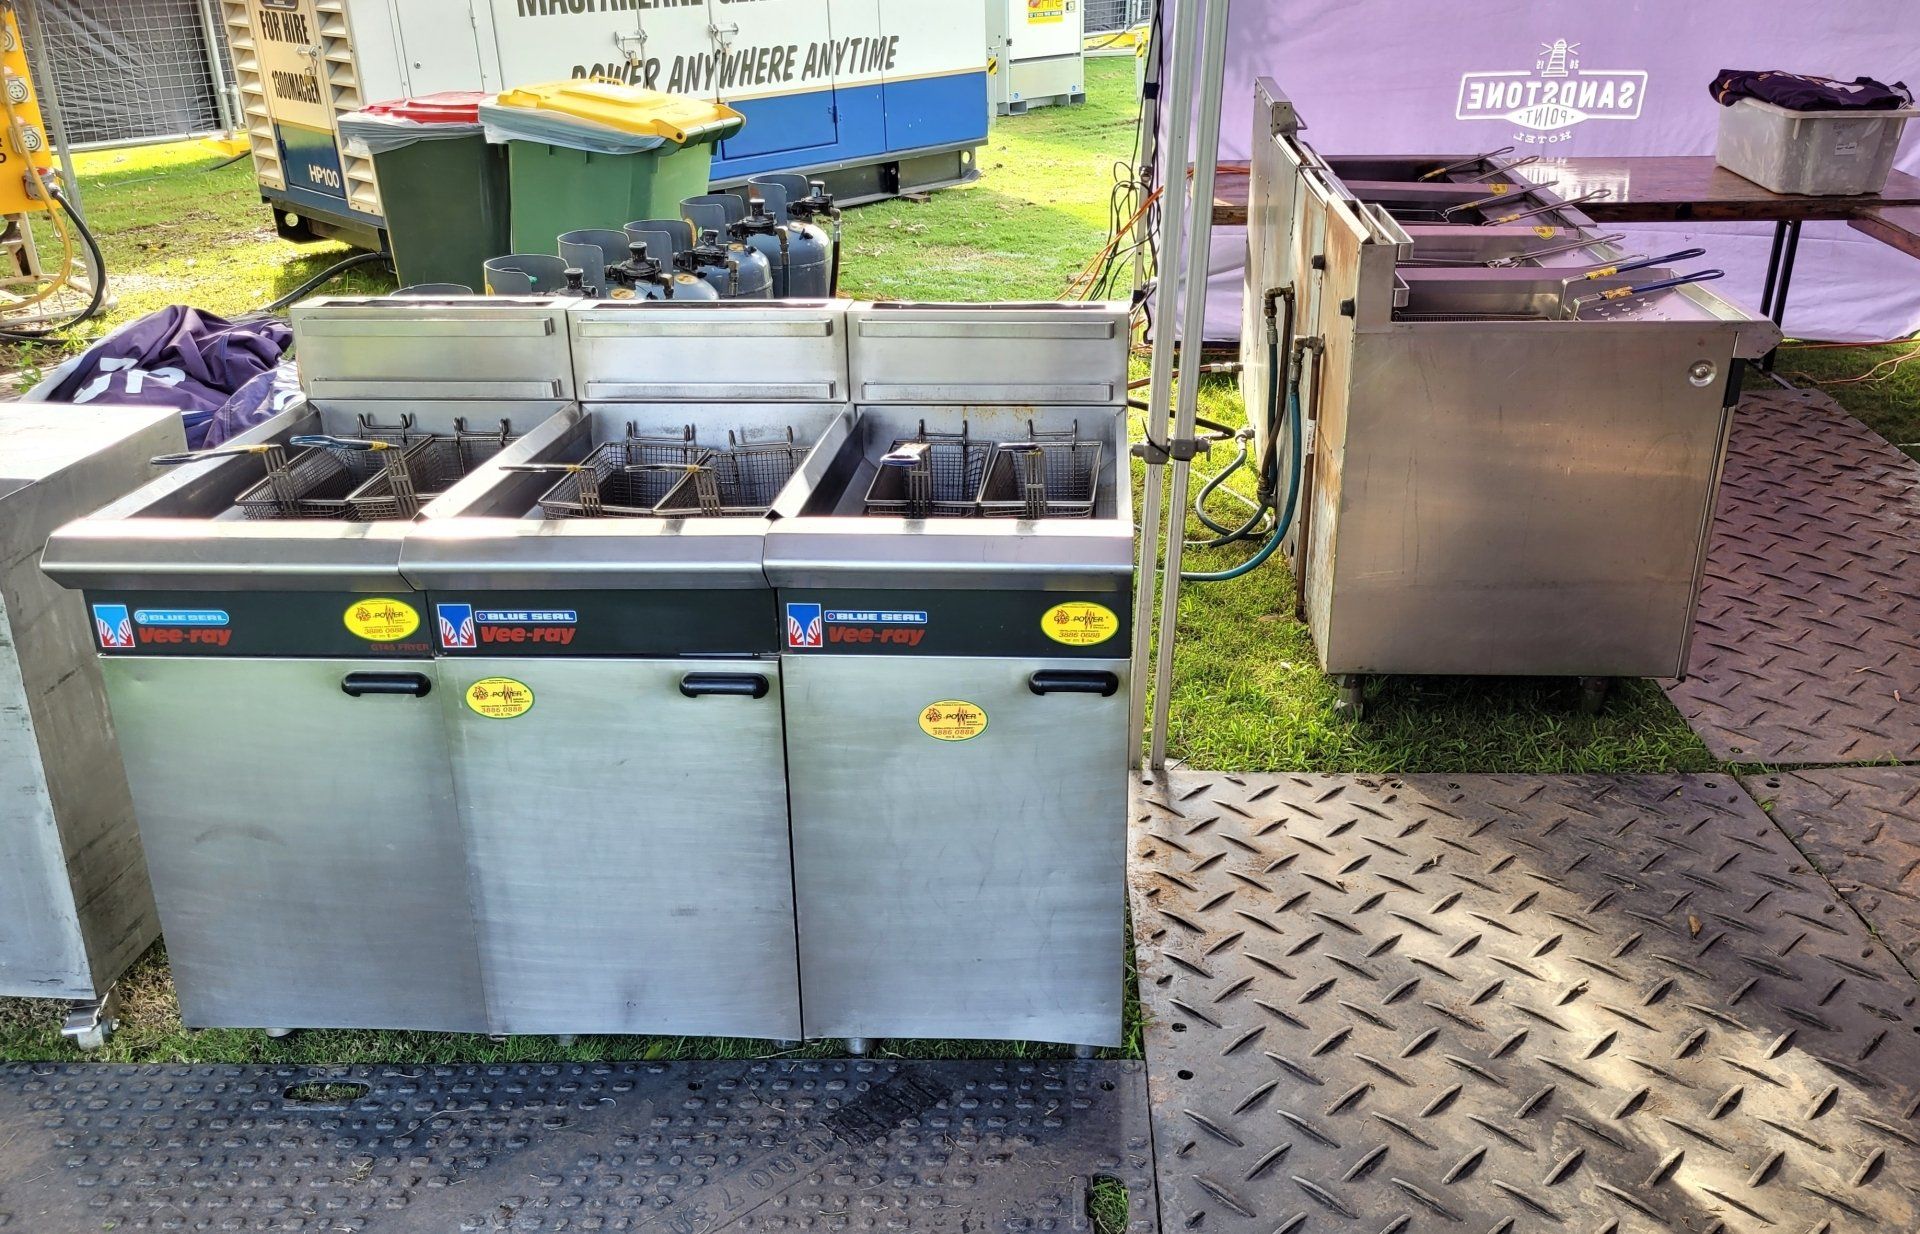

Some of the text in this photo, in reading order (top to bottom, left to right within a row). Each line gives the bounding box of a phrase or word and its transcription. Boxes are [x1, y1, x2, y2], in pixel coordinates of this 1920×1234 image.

[259, 10, 311, 45] FOR HIRE
[666, 44, 798, 94] ANYWHERE
[801, 35, 900, 81] ANYTIME
[308, 163, 341, 189] HP100
[881, 613, 924, 621] SEAL
[138, 627, 233, 646] Vee-ray
[480, 626, 576, 645] Vee-ray
[828, 626, 925, 647] Vee-ray
